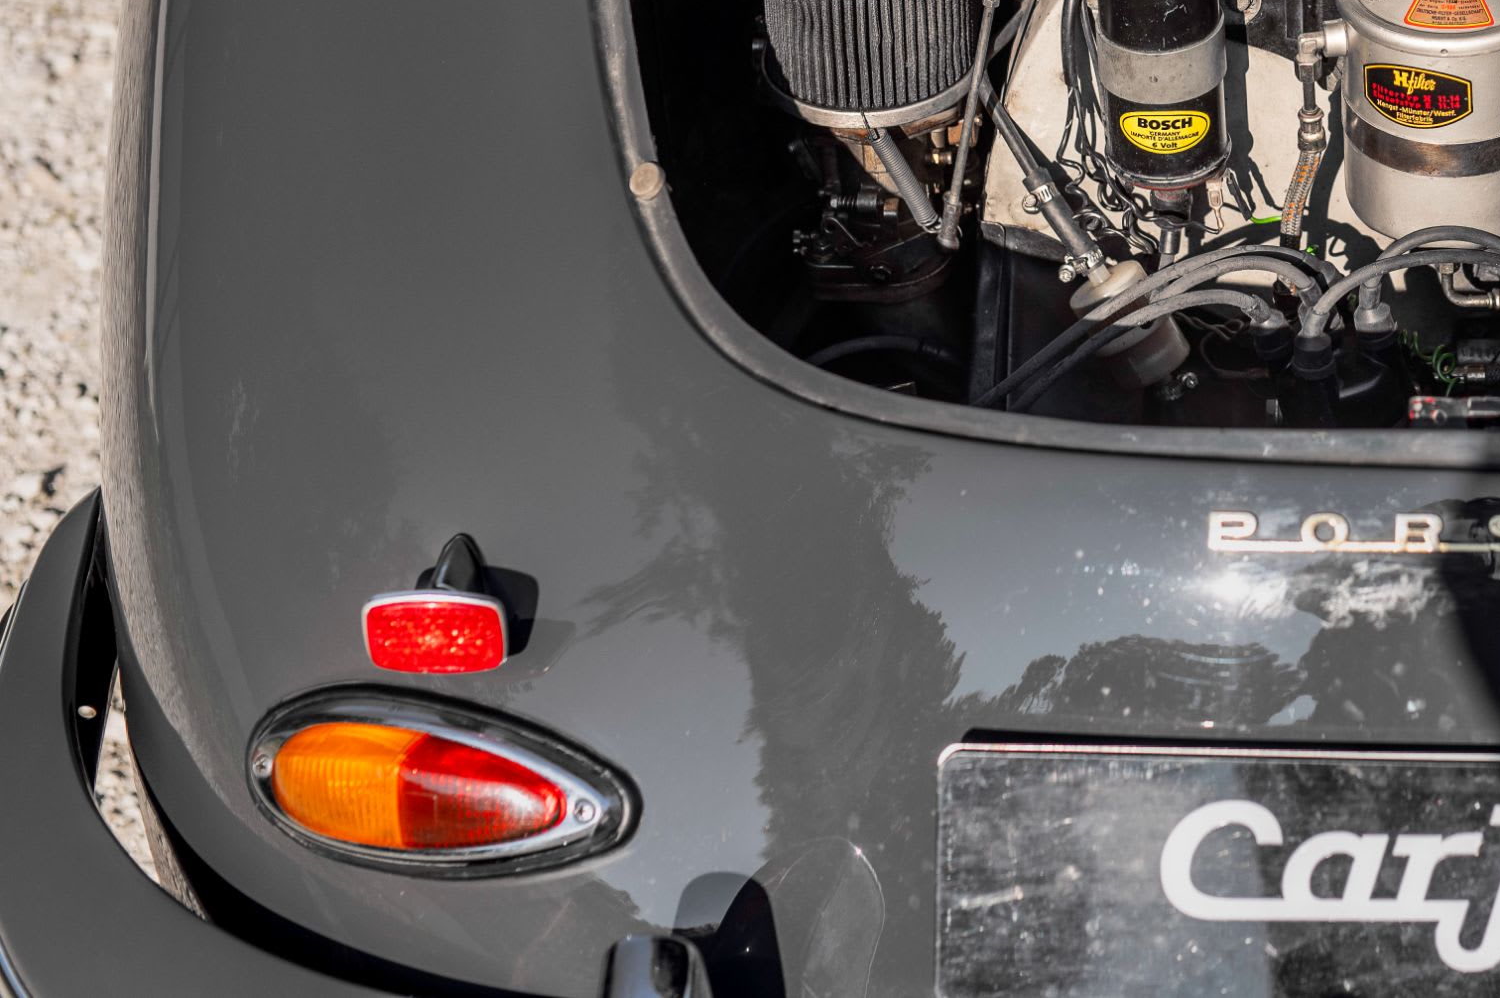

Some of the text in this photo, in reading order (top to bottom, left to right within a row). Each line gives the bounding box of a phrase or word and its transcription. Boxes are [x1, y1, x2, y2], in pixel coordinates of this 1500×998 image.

[1396, 112, 1434, 122] Filterfabrik
[1137, 117, 1193, 130] BOSCH
[1158, 132, 1199, 141] D'ALLEMAGNE
